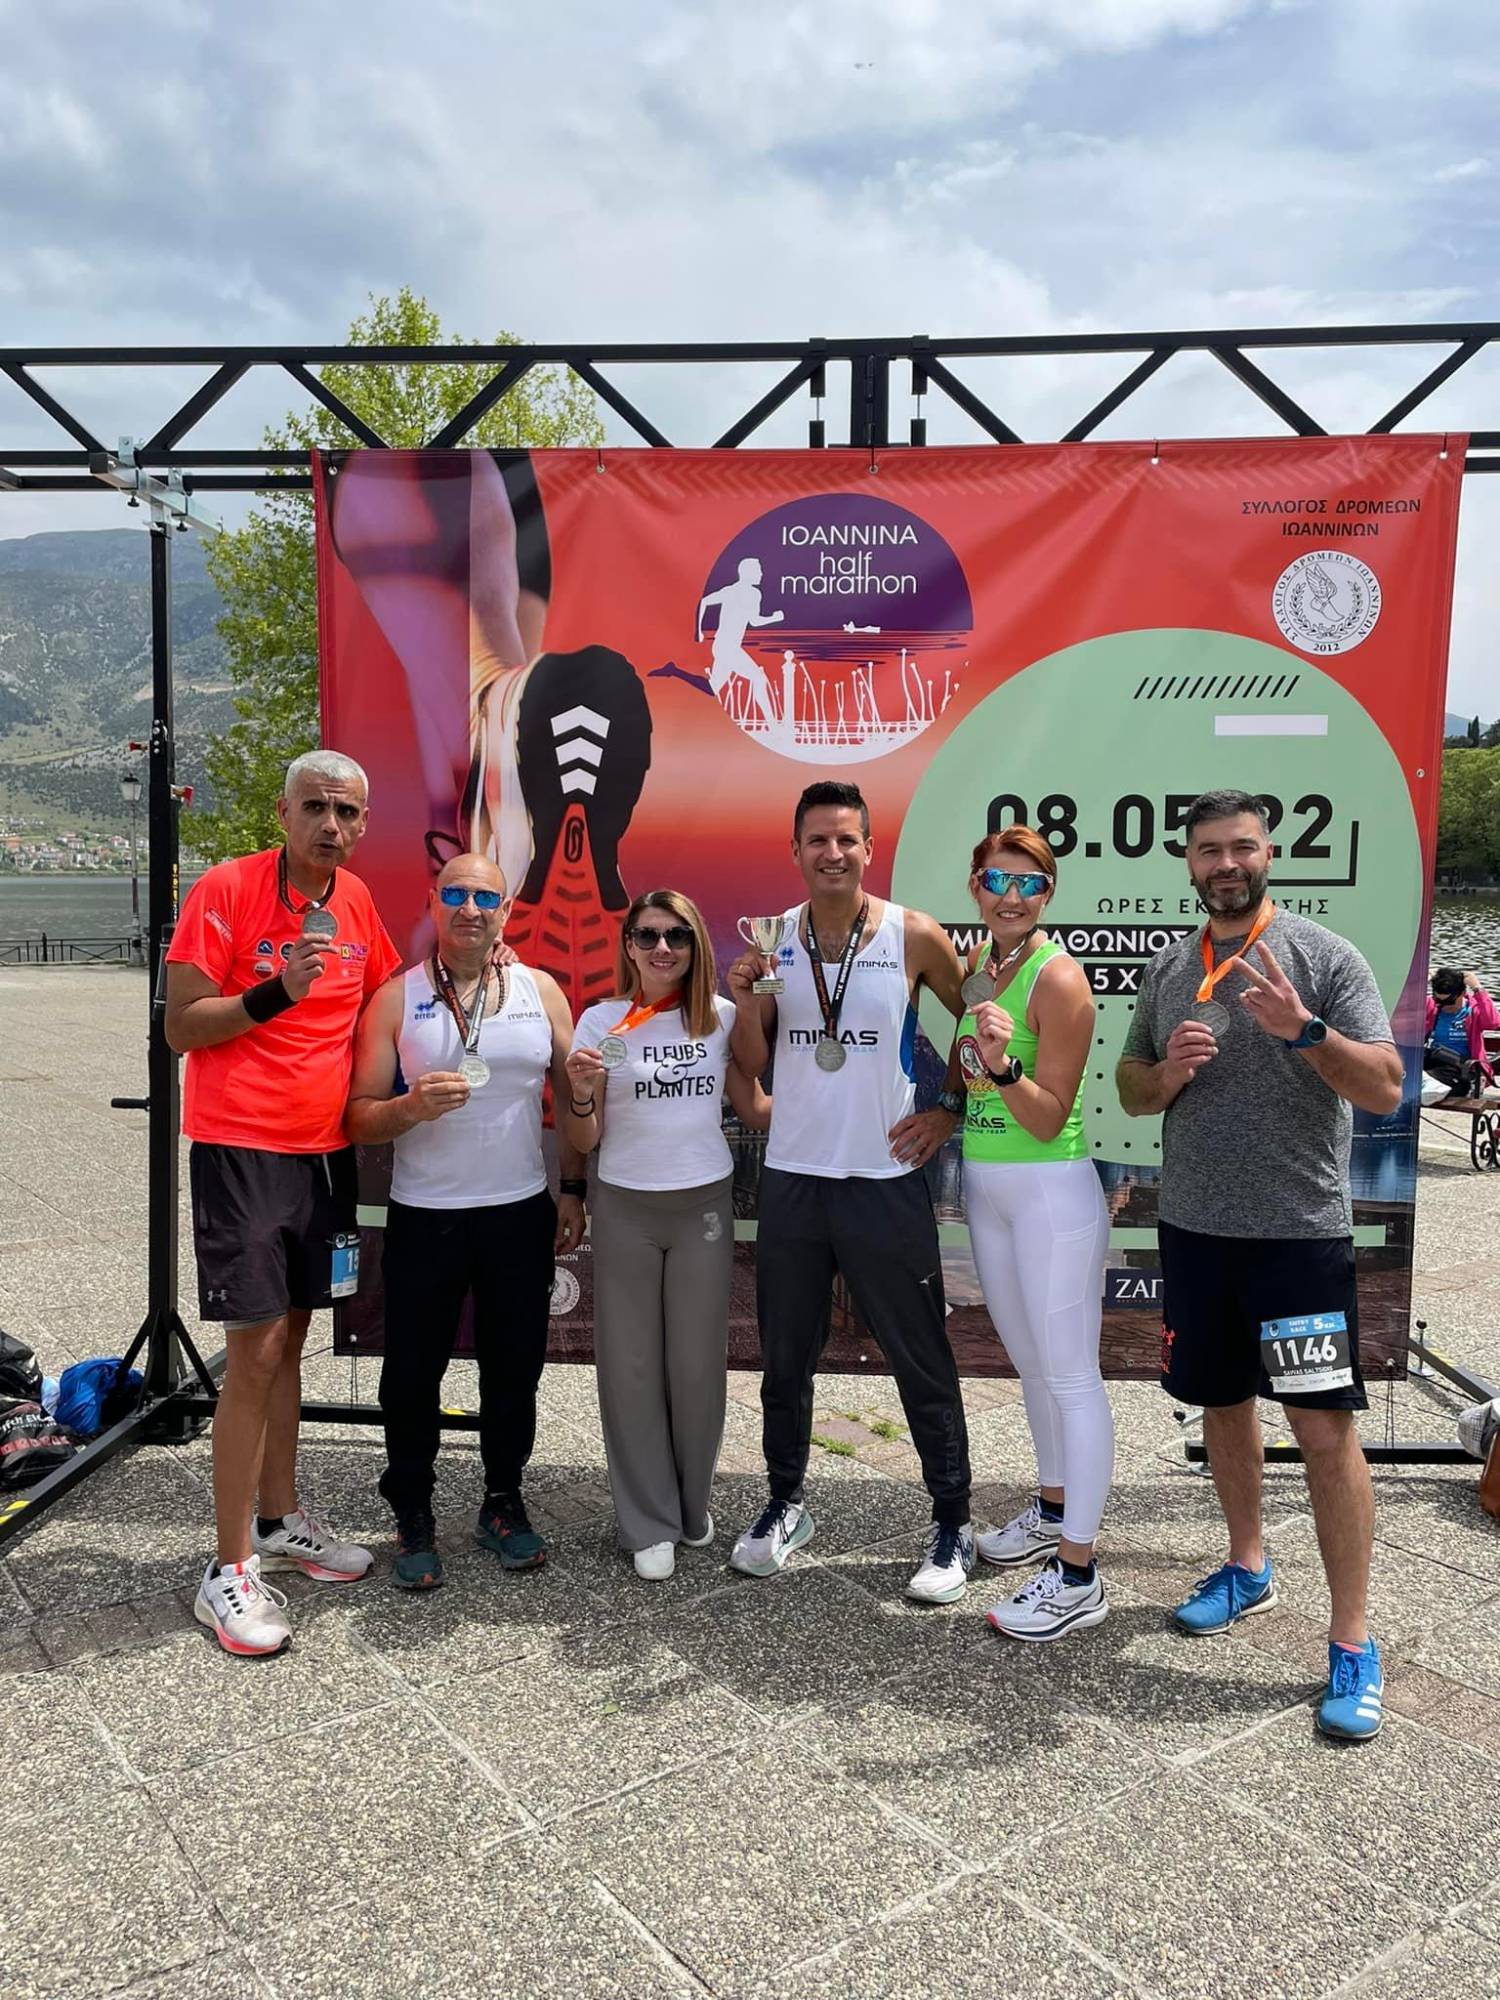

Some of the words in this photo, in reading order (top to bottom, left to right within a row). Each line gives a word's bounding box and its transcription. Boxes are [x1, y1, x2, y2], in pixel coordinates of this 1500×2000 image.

[1242, 500, 1328, 515] ΣΥΛΛΟΓΟΣ
[1336, 499, 1421, 514] ΔΡΟΜΕΩΝ
[782, 525, 918, 545] IOANNINA
[1282, 522, 1379, 536] ΙΩΑΝΝΙΝΩΝ
[820, 551, 873, 575] half
[781, 574, 917, 594] marathon
[1313, 643, 1340, 652] 2012
[1097, 898, 1164, 914] ΩΡΕΣ
[1093, 968, 1109, 990] 5
[653, 1055, 699, 1088] &
[635, 1075, 716, 1099] PLANTES
[1272, 1334, 1338, 1367] 1146
